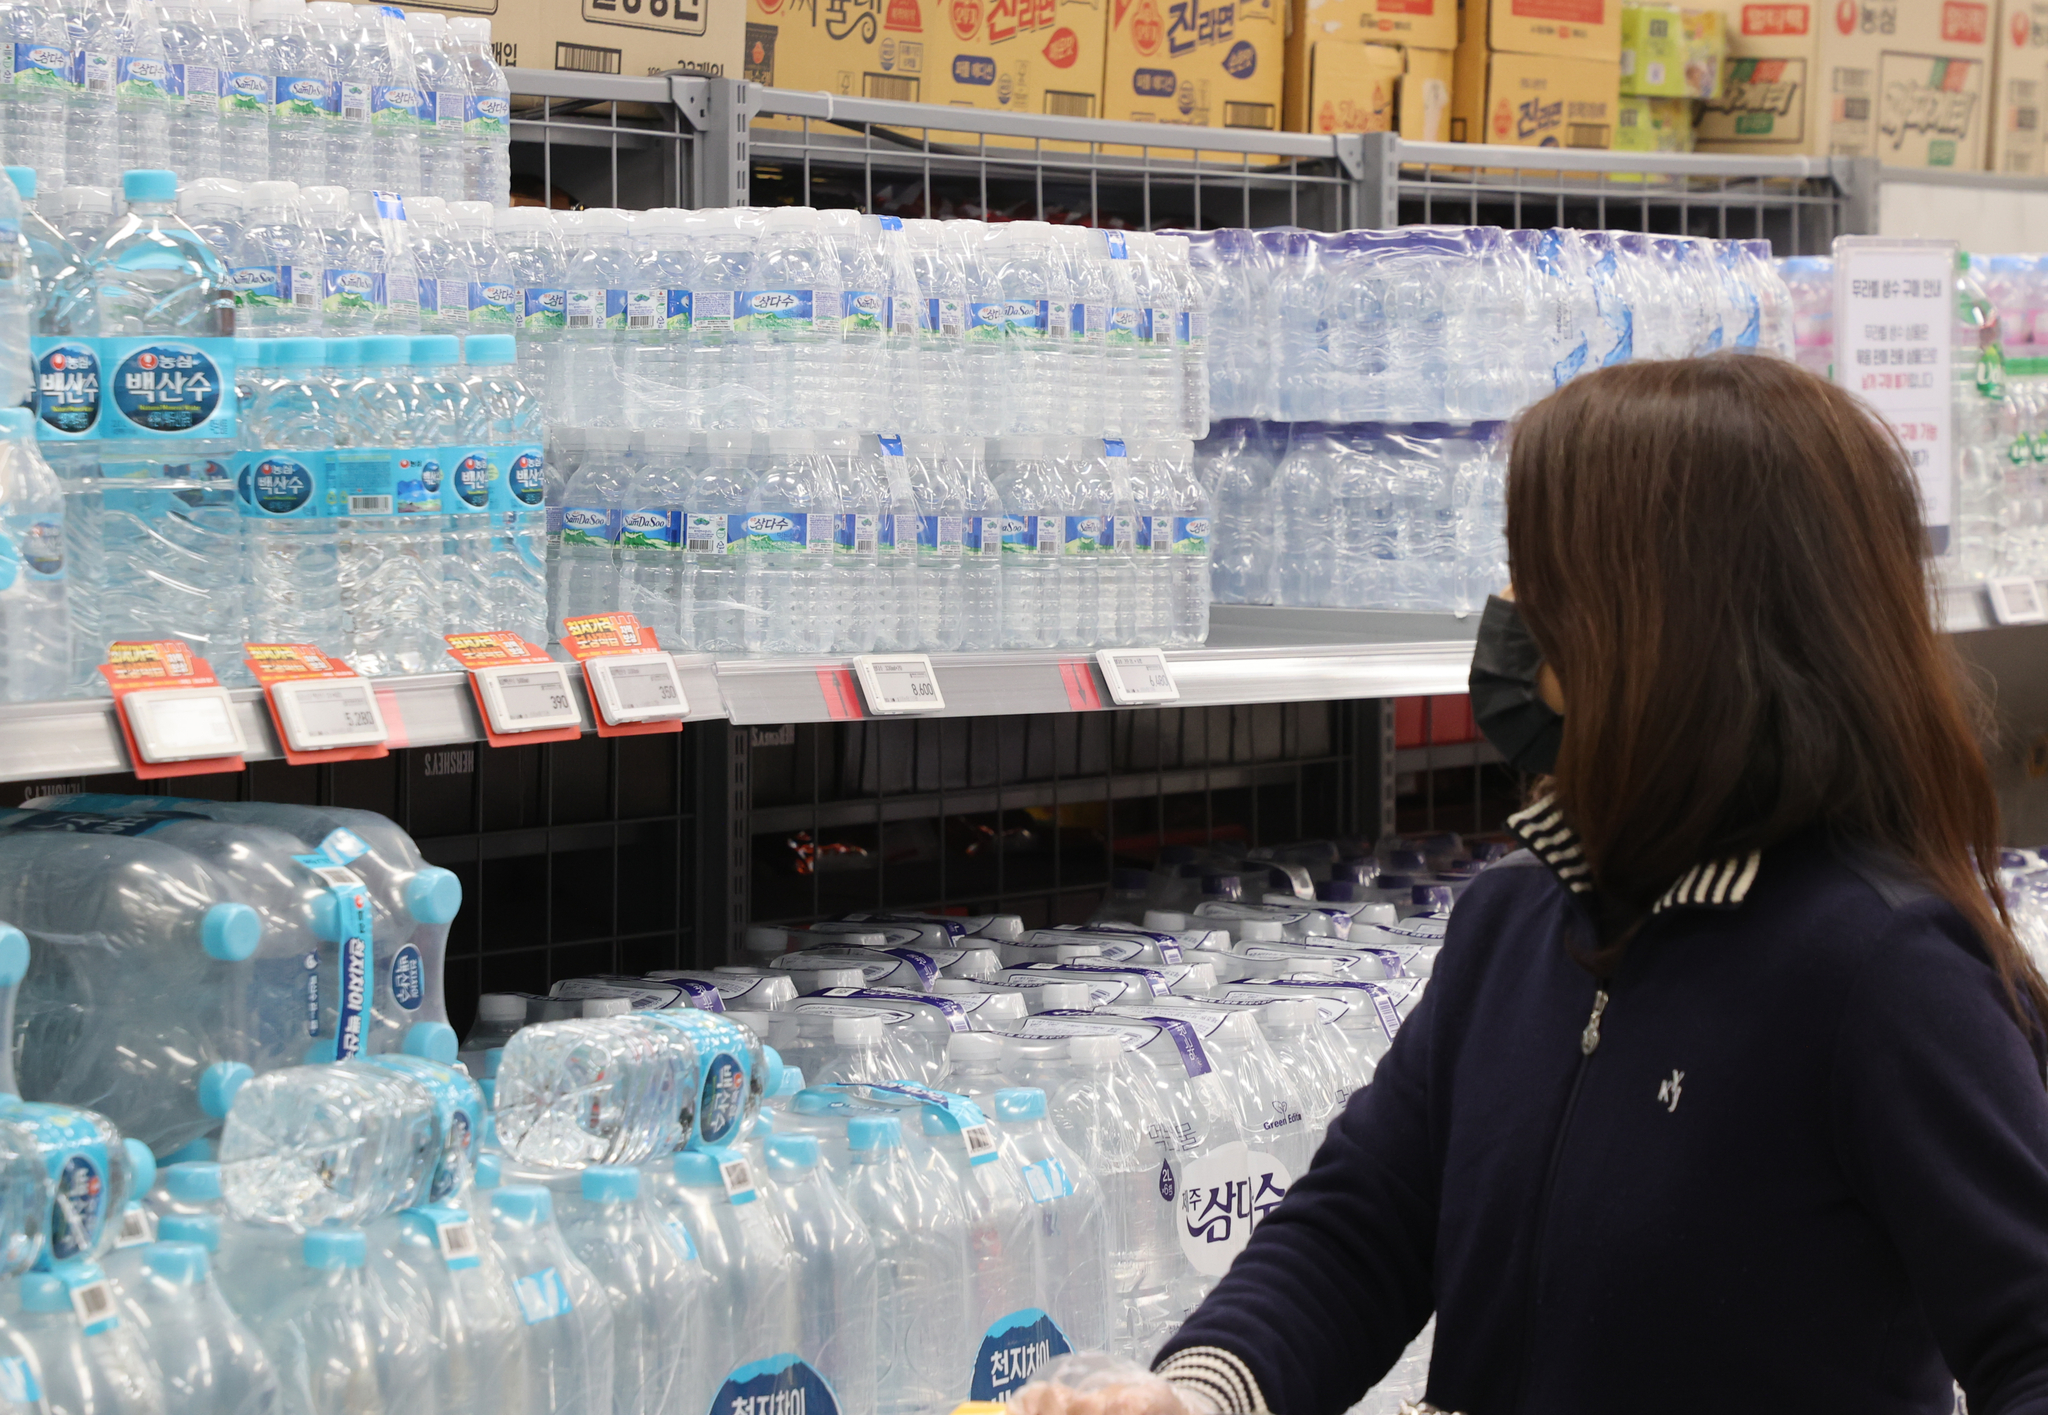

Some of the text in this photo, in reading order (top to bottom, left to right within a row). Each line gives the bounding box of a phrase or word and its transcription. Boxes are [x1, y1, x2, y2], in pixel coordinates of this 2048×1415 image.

[756, 294, 795, 309] 삼다수
[66, 355, 90, 370] 농심
[158, 354, 194, 369] 농심
[40, 372, 99, 404] 백산수
[125, 371, 213, 404] 백산수
[257, 476, 304, 496] 백산수
[564, 511, 606, 528] SamDaSoo
[623, 514, 665, 529] SamDaSoo
[753, 517, 789, 531] 삼다수
[659, 685, 677, 699] 350
[911, 683, 934, 696] 8,600
[550, 694, 569, 710] 390
[424, 750, 474, 776] HERSHEY'S
[347, 936, 366, 1011] 천지차이
[394, 955, 411, 1003] 백산수
[710, 1063, 734, 1134] 백산수
[1263, 1118, 1287, 1130] Green
[1162, 1168, 1173, 1182] 2L
[1186, 1172, 1286, 1244] 삼다수
[990, 1338, 1050, 1388] 천지차이
